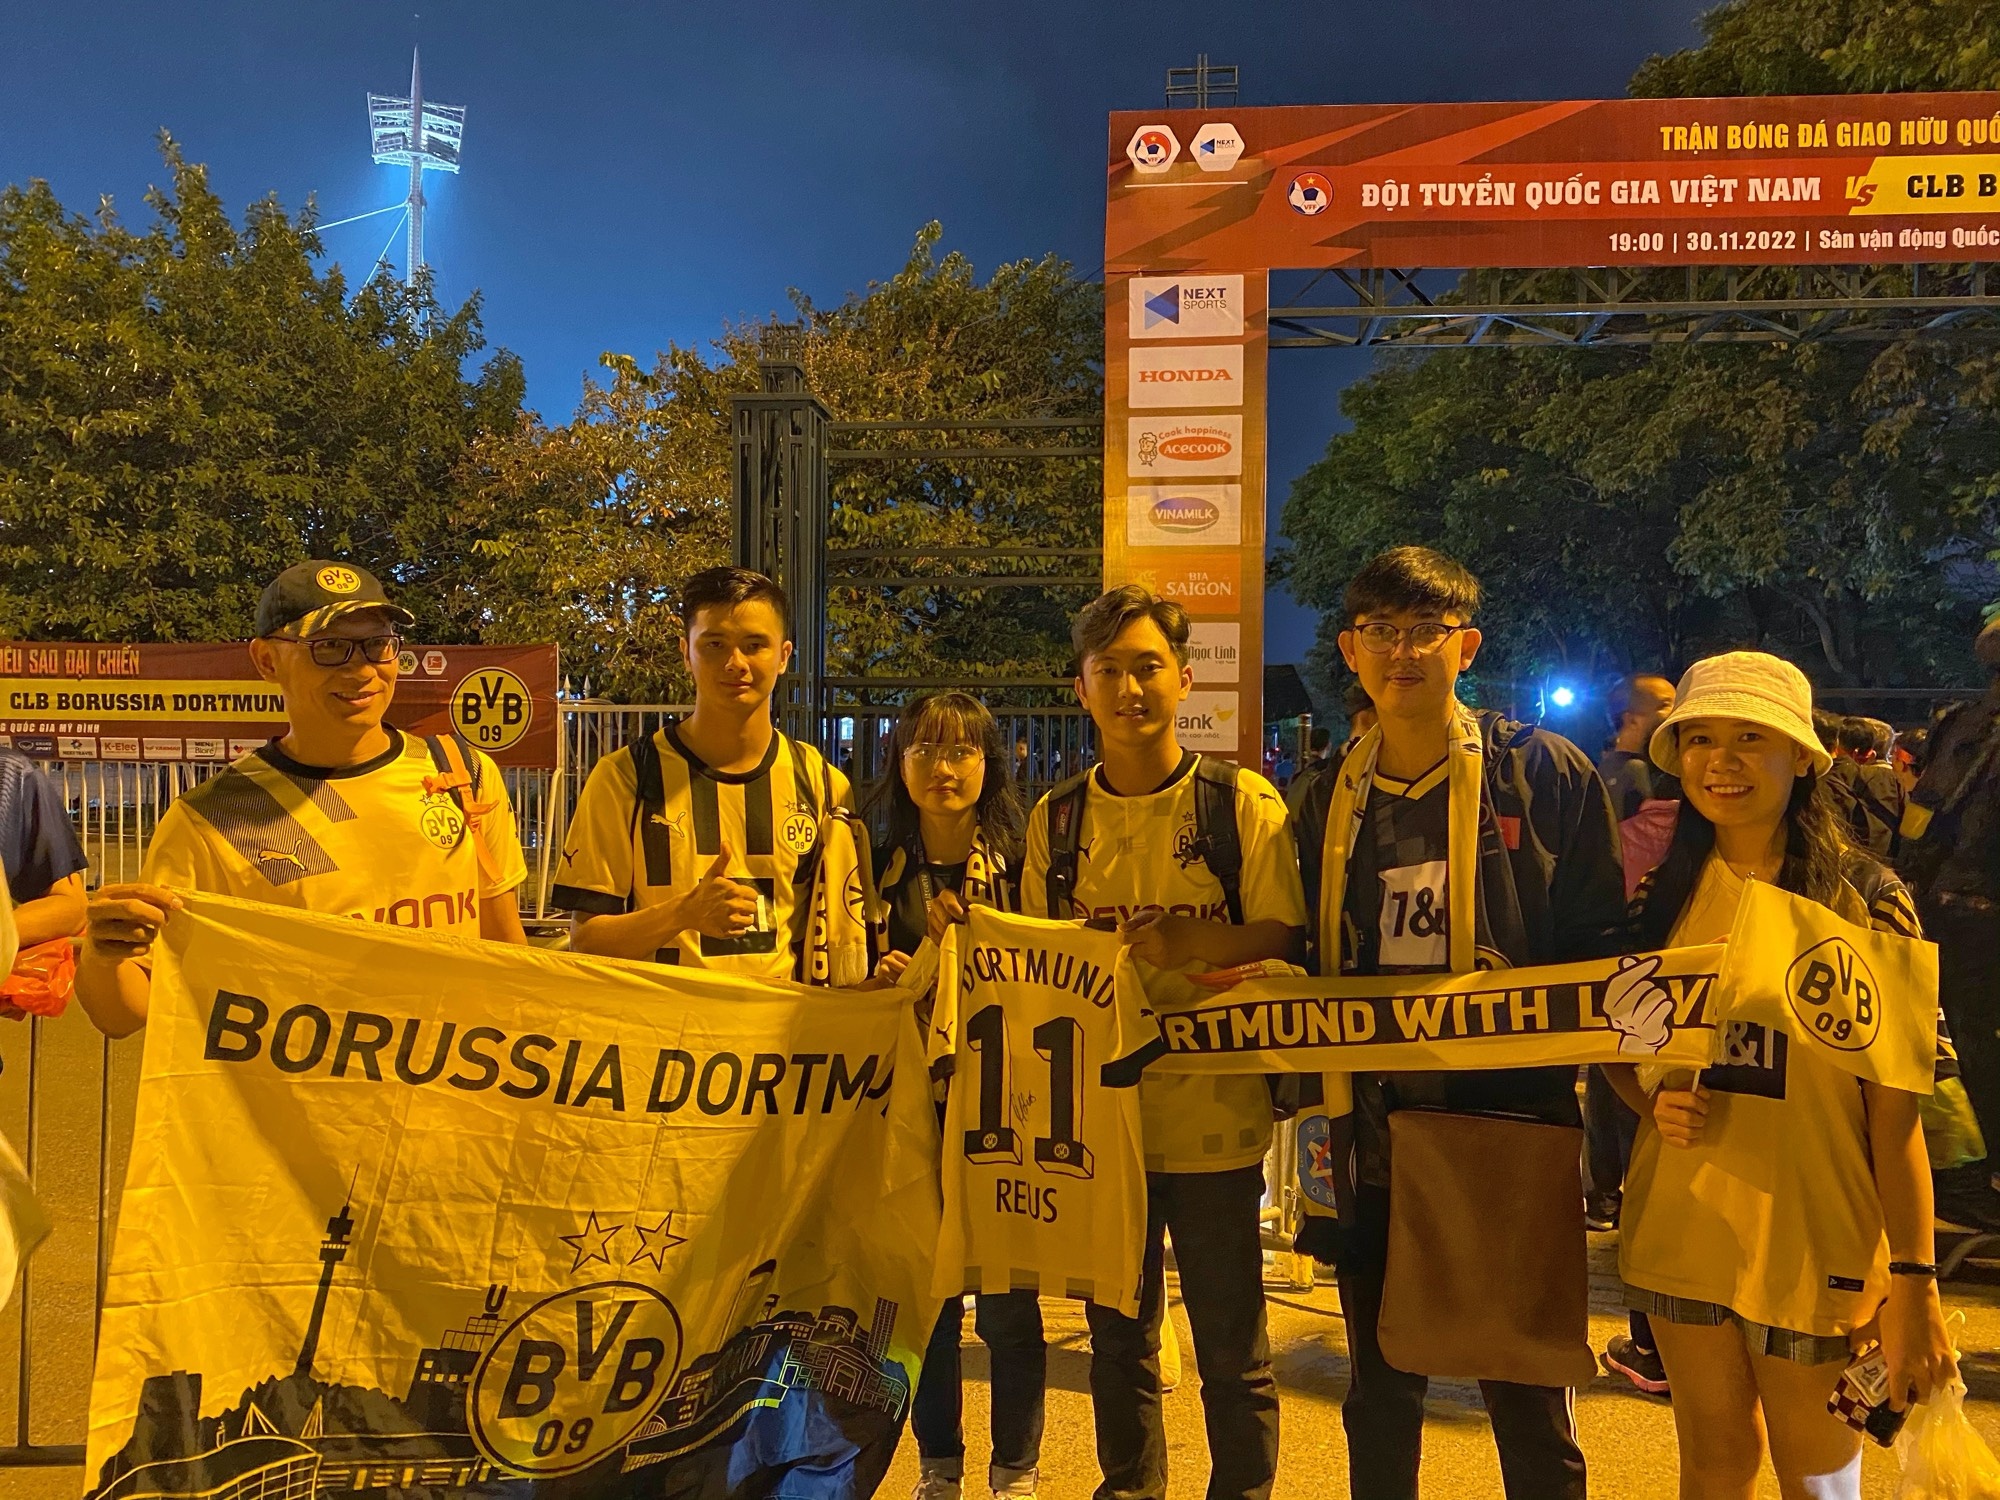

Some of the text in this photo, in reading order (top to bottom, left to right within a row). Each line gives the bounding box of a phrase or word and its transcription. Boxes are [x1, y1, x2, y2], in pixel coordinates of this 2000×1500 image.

[1660, 122, 1718, 154] TRẬN
[1727, 120, 1789, 149] BÓNG
[1797, 118, 1828, 148] ĐÁ
[1836, 121, 1892, 147] GIAO
[1900, 116, 1948, 145] HỮU
[1361, 172, 1821, 212] ĐỘI TUYỂN QUỐC GIA VIỆT NAM
[1845, 175, 1878, 207] VS
[1907, 174, 1965, 198] CLB
[1609, 225, 2000, 252] 19:00 30.11.2022 Sân vận động Quốc
[1183, 287, 1227, 300] NEXT
[1183, 299, 1227, 310] SPORTS
[1138, 368, 1233, 383] HONDA
[1158, 425, 1232, 440] Cook happiness
[1154, 508, 1214, 520] VINAMILK
[322, 569, 355, 586] BVB
[1166, 581, 1232, 596] SAIGON
[1189, 572, 1209, 582] BIA
[29, 649, 59, 674] SAO
[1214, 645, 1236, 659] Linh
[10, 692, 285, 713] CLB BORUSSIA DORTMUN
[461, 676, 523, 725] BVB
[479, 725, 502, 742] 09
[1174, 714, 1213, 730] ank
[104, 742, 137, 751] K-Elec
[425, 810, 461, 838] BVB
[787, 818, 814, 843] BVB
[440, 834, 453, 845] 09
[795, 841, 805, 850] 09
[1391, 886, 1446, 938] 1&
[963, 946, 1116, 1009] DORTMUND
[1796, 945, 1873, 1026] BVB
[1164, 1000, 1376, 1050] RTMUND
[1392, 988, 1549, 1040] WITH
[1814, 1011, 1852, 1041] 09
[203, 988, 626, 1112] BORUSSIA
[645, 1047, 895, 1120] DORTM
[1723, 1019, 1774, 1070] &1
[962, 1003, 1095, 1180] 11
[996, 1177, 1058, 1224] REUS
[497, 1300, 666, 1420] BVB
[532, 1416, 594, 1457] 09
